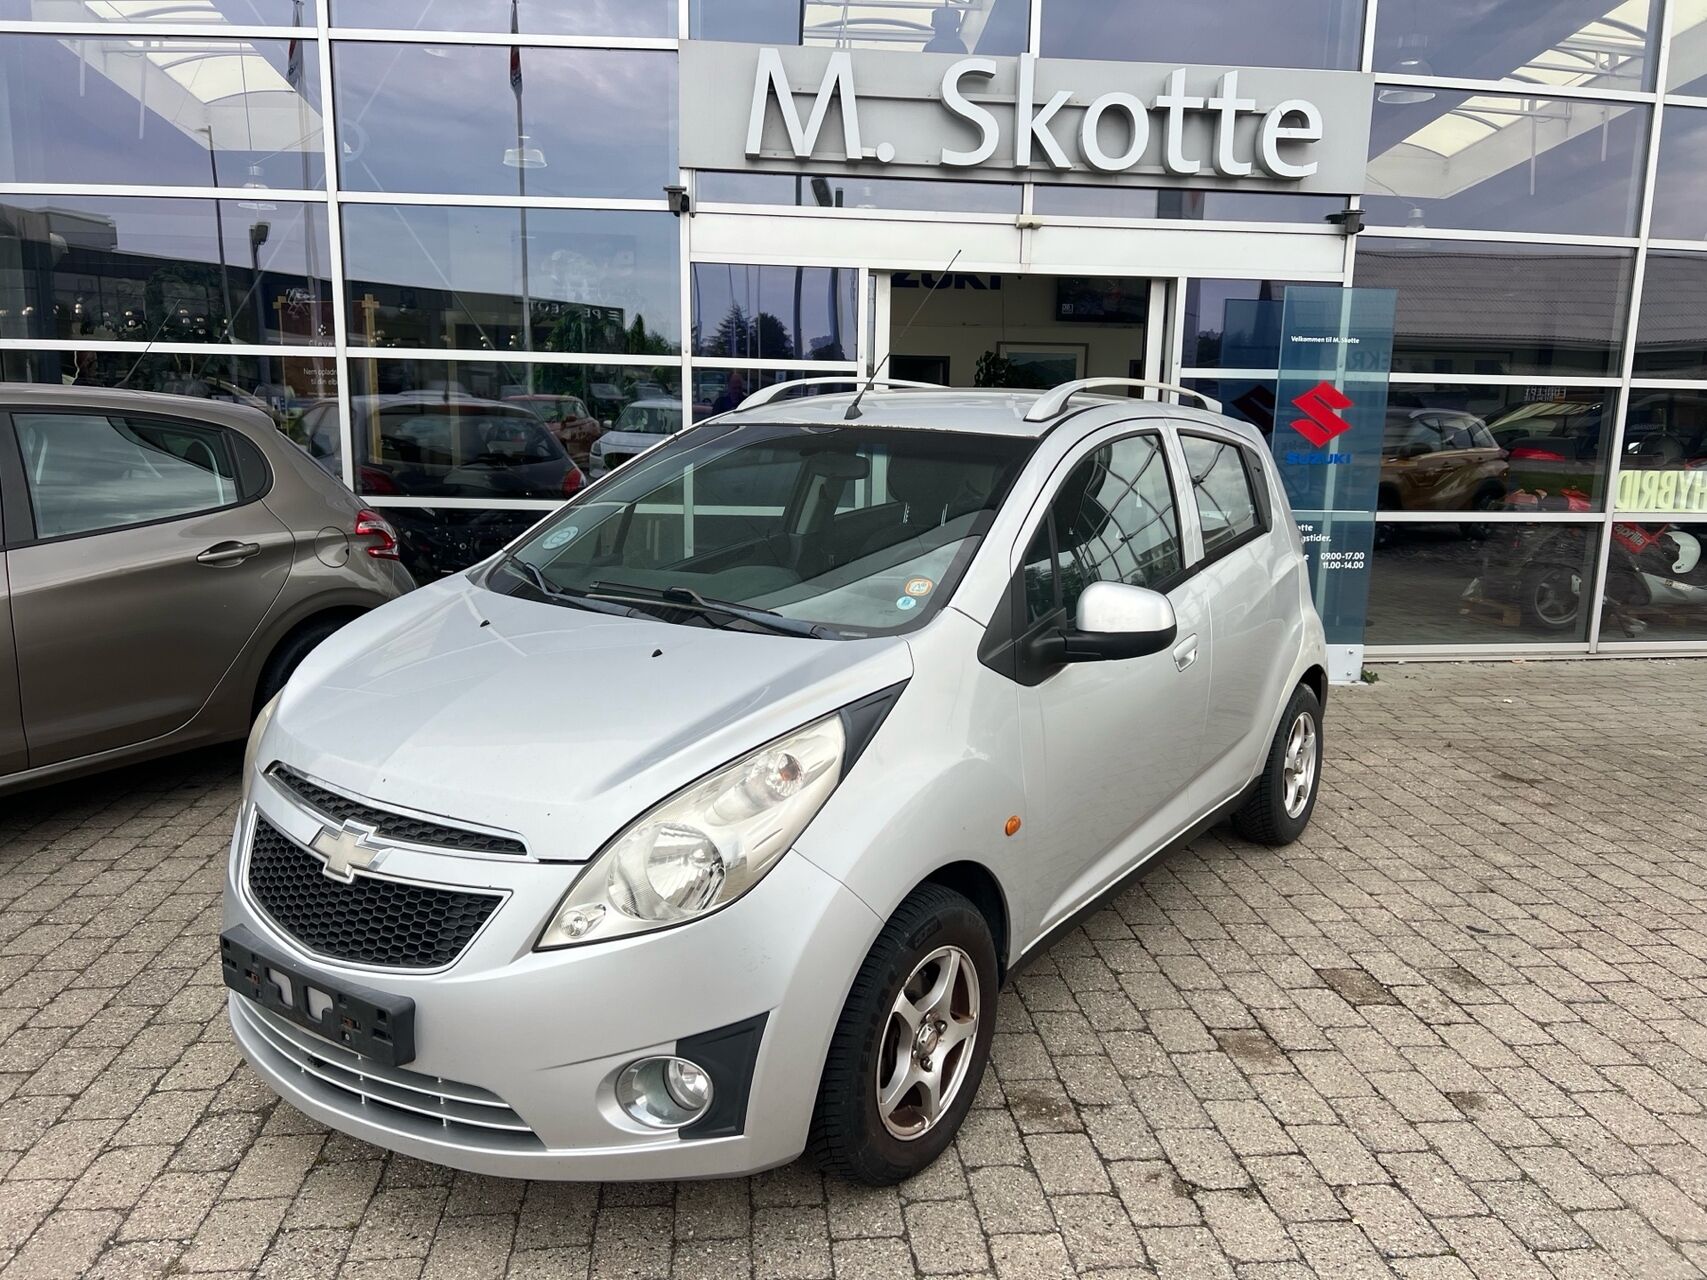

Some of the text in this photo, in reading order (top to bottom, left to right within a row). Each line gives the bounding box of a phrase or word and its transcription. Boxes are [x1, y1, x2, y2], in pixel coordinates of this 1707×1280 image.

[745, 47, 1324, 180] M. Skotte
[1290, 335, 1325, 343] Velkommen
[1325, 336, 1333, 344] til
[303, 367, 317, 375] Nem
[1286, 451, 1352, 465] SUZUKI
[1614, 523, 1645, 546] aprilia
[1320, 552, 1365, 561] 09.00-17.00
[1322, 561, 1364, 569] 11.00-14.00
